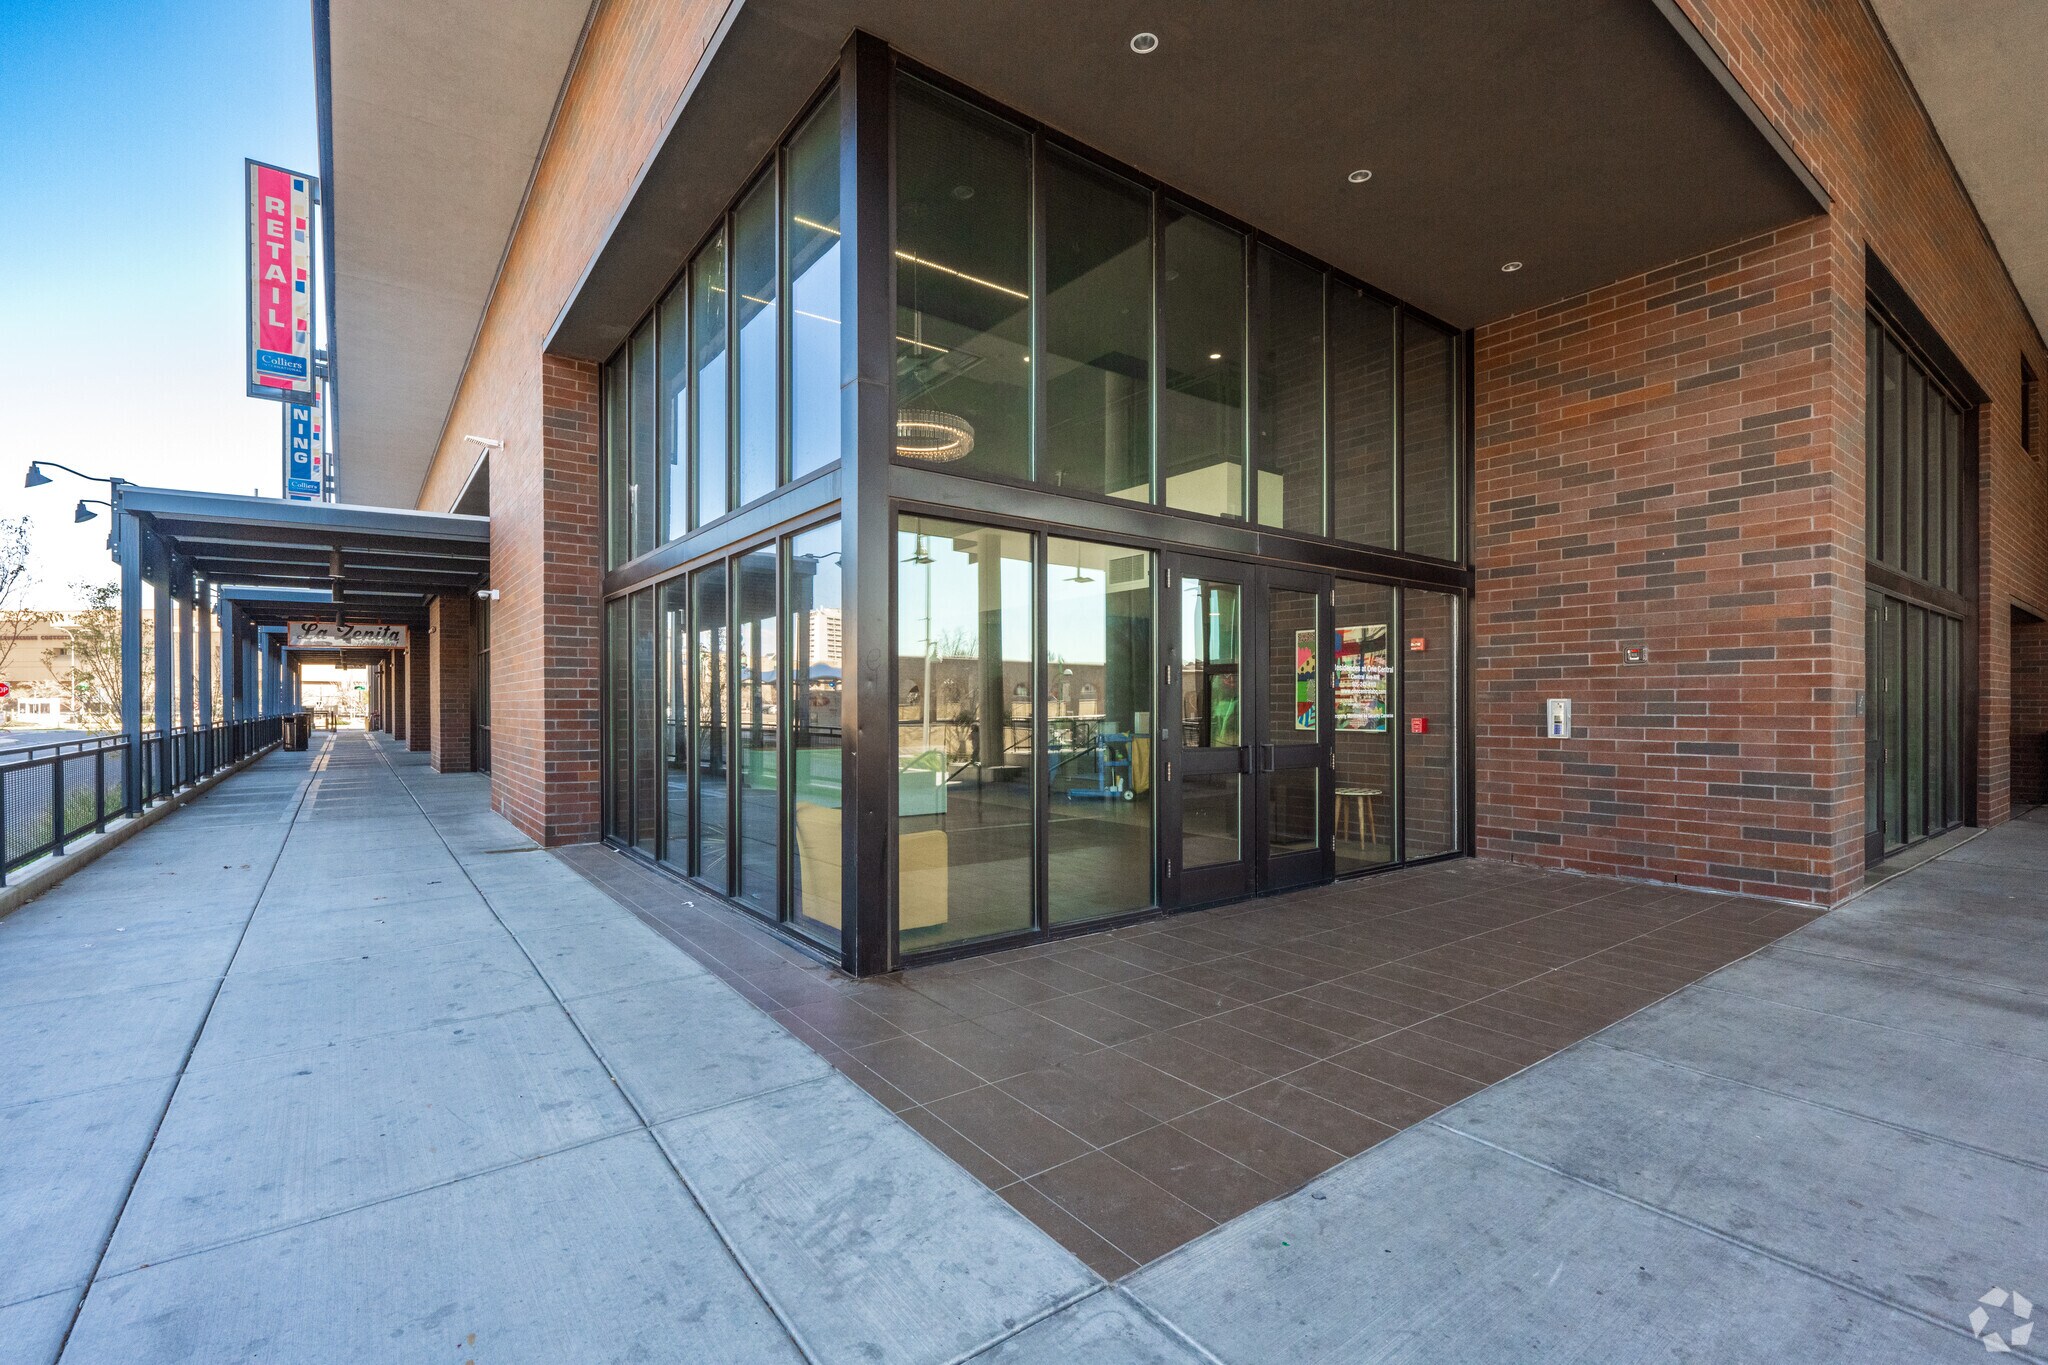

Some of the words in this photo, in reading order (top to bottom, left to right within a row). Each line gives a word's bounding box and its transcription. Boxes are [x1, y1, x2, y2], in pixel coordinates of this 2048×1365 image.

[265, 195, 286, 328] RETAIL
[262, 354, 302, 369] Colliers
[291, 481, 317, 489] Colliers
[297, 623, 328, 639] La
